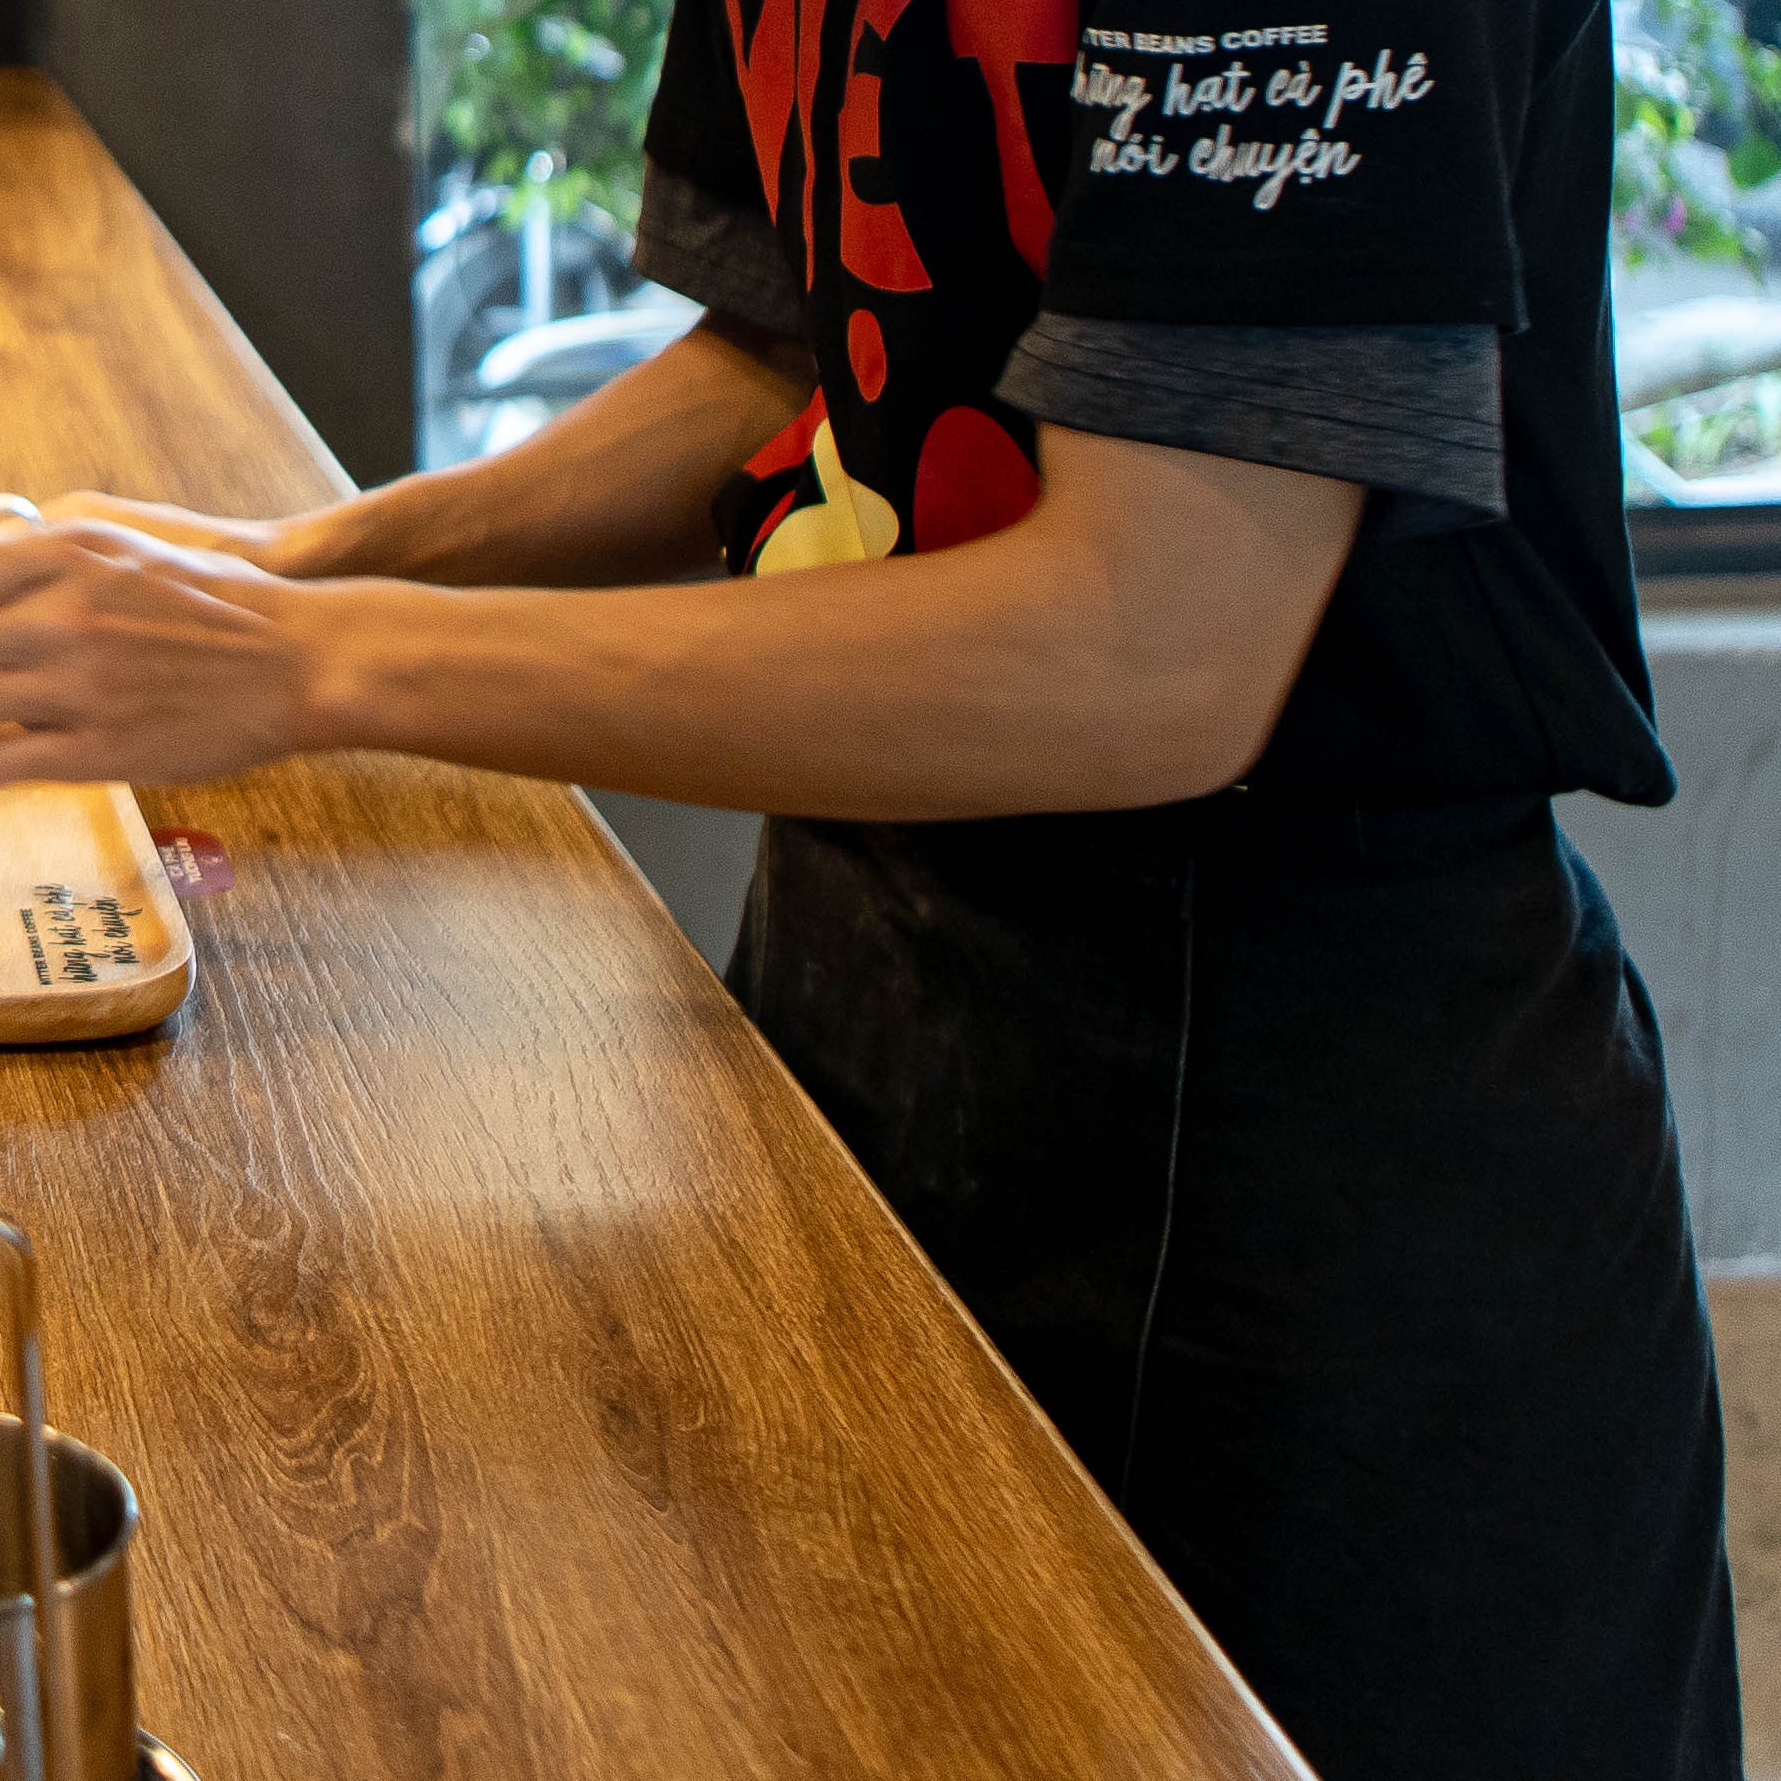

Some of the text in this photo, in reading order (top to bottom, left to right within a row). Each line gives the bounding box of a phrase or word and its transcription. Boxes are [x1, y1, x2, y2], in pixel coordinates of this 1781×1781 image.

[1132, 32, 1218, 56] BEANS
[1219, 23, 1331, 50] COFFEE
[1162, 60, 1258, 118] hạt
[1265, 60, 1324, 109] cà
[1322, 48, 1438, 131] phê
[1089, 122, 1364, 212] nói chuyện
